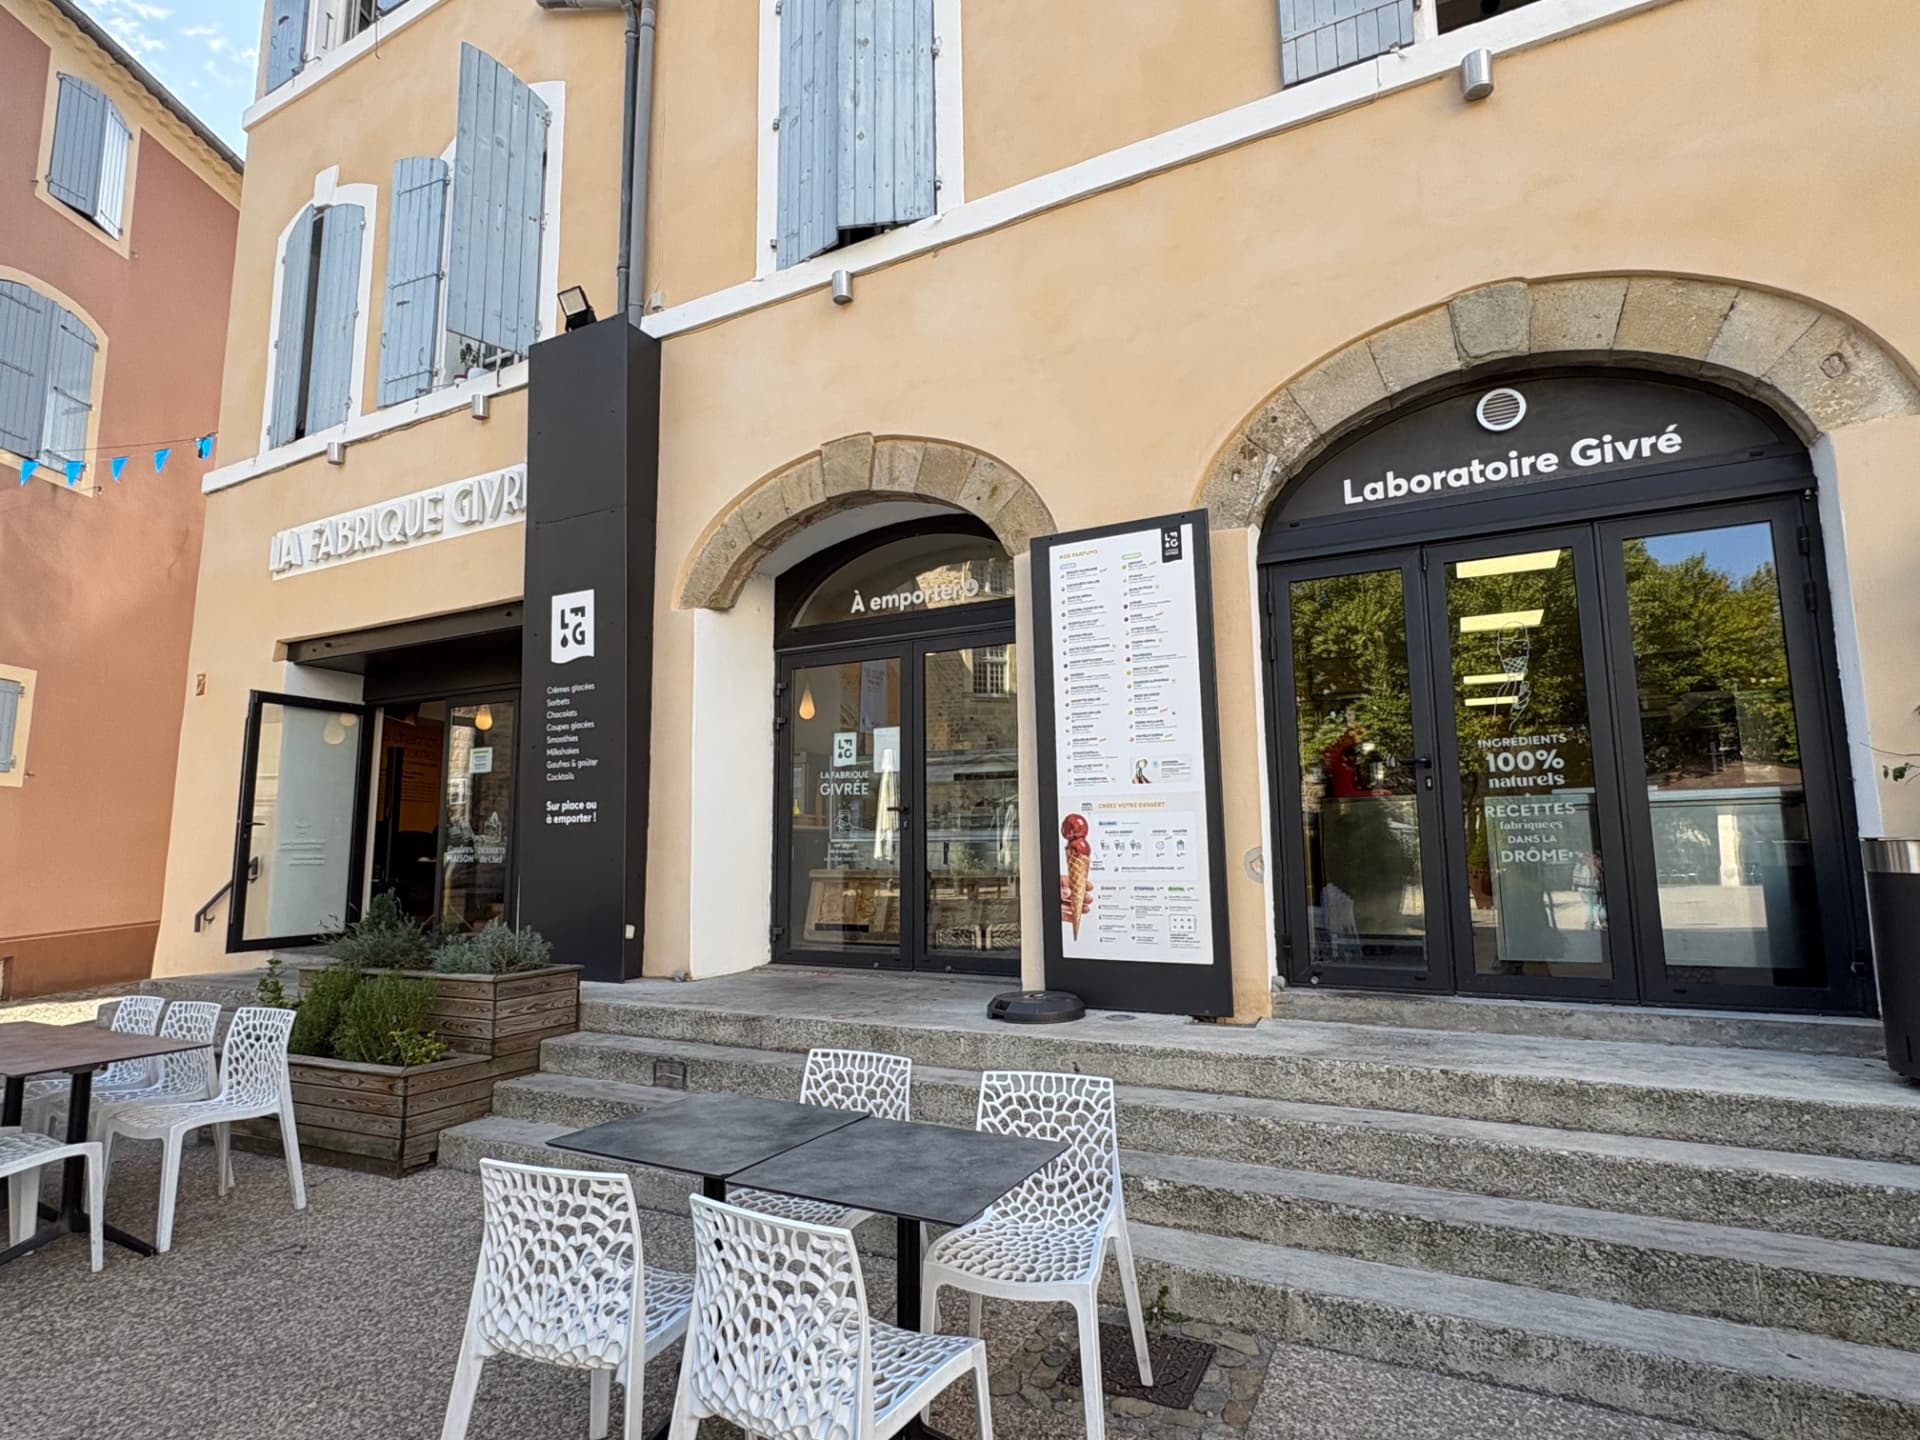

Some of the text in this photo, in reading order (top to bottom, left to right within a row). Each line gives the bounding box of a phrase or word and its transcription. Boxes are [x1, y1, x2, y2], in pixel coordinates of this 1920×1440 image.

[1343, 424, 1682, 504] Laboratoire Givré
[309, 491, 444, 562] FABRIQUE
[453, 472, 526, 523] GIVR
[851, 583, 960, 614] À emporter
[571, 683, 595, 694] glacées
[546, 721, 595, 733] Coupes glacées
[546, 735, 579, 744] Smoothies
[1485, 749, 1565, 773] 100%
[820, 770, 869, 779] LA FABRIQUE
[1488, 772, 1565, 789] naturels
[820, 779, 869, 796] GIVRÉE
[546, 799, 597, 813] Sur place ou
[1485, 802, 1576, 818] RECETTES
[546, 811, 597, 826] à emporter !
[1507, 834, 1557, 844] DANS LA
